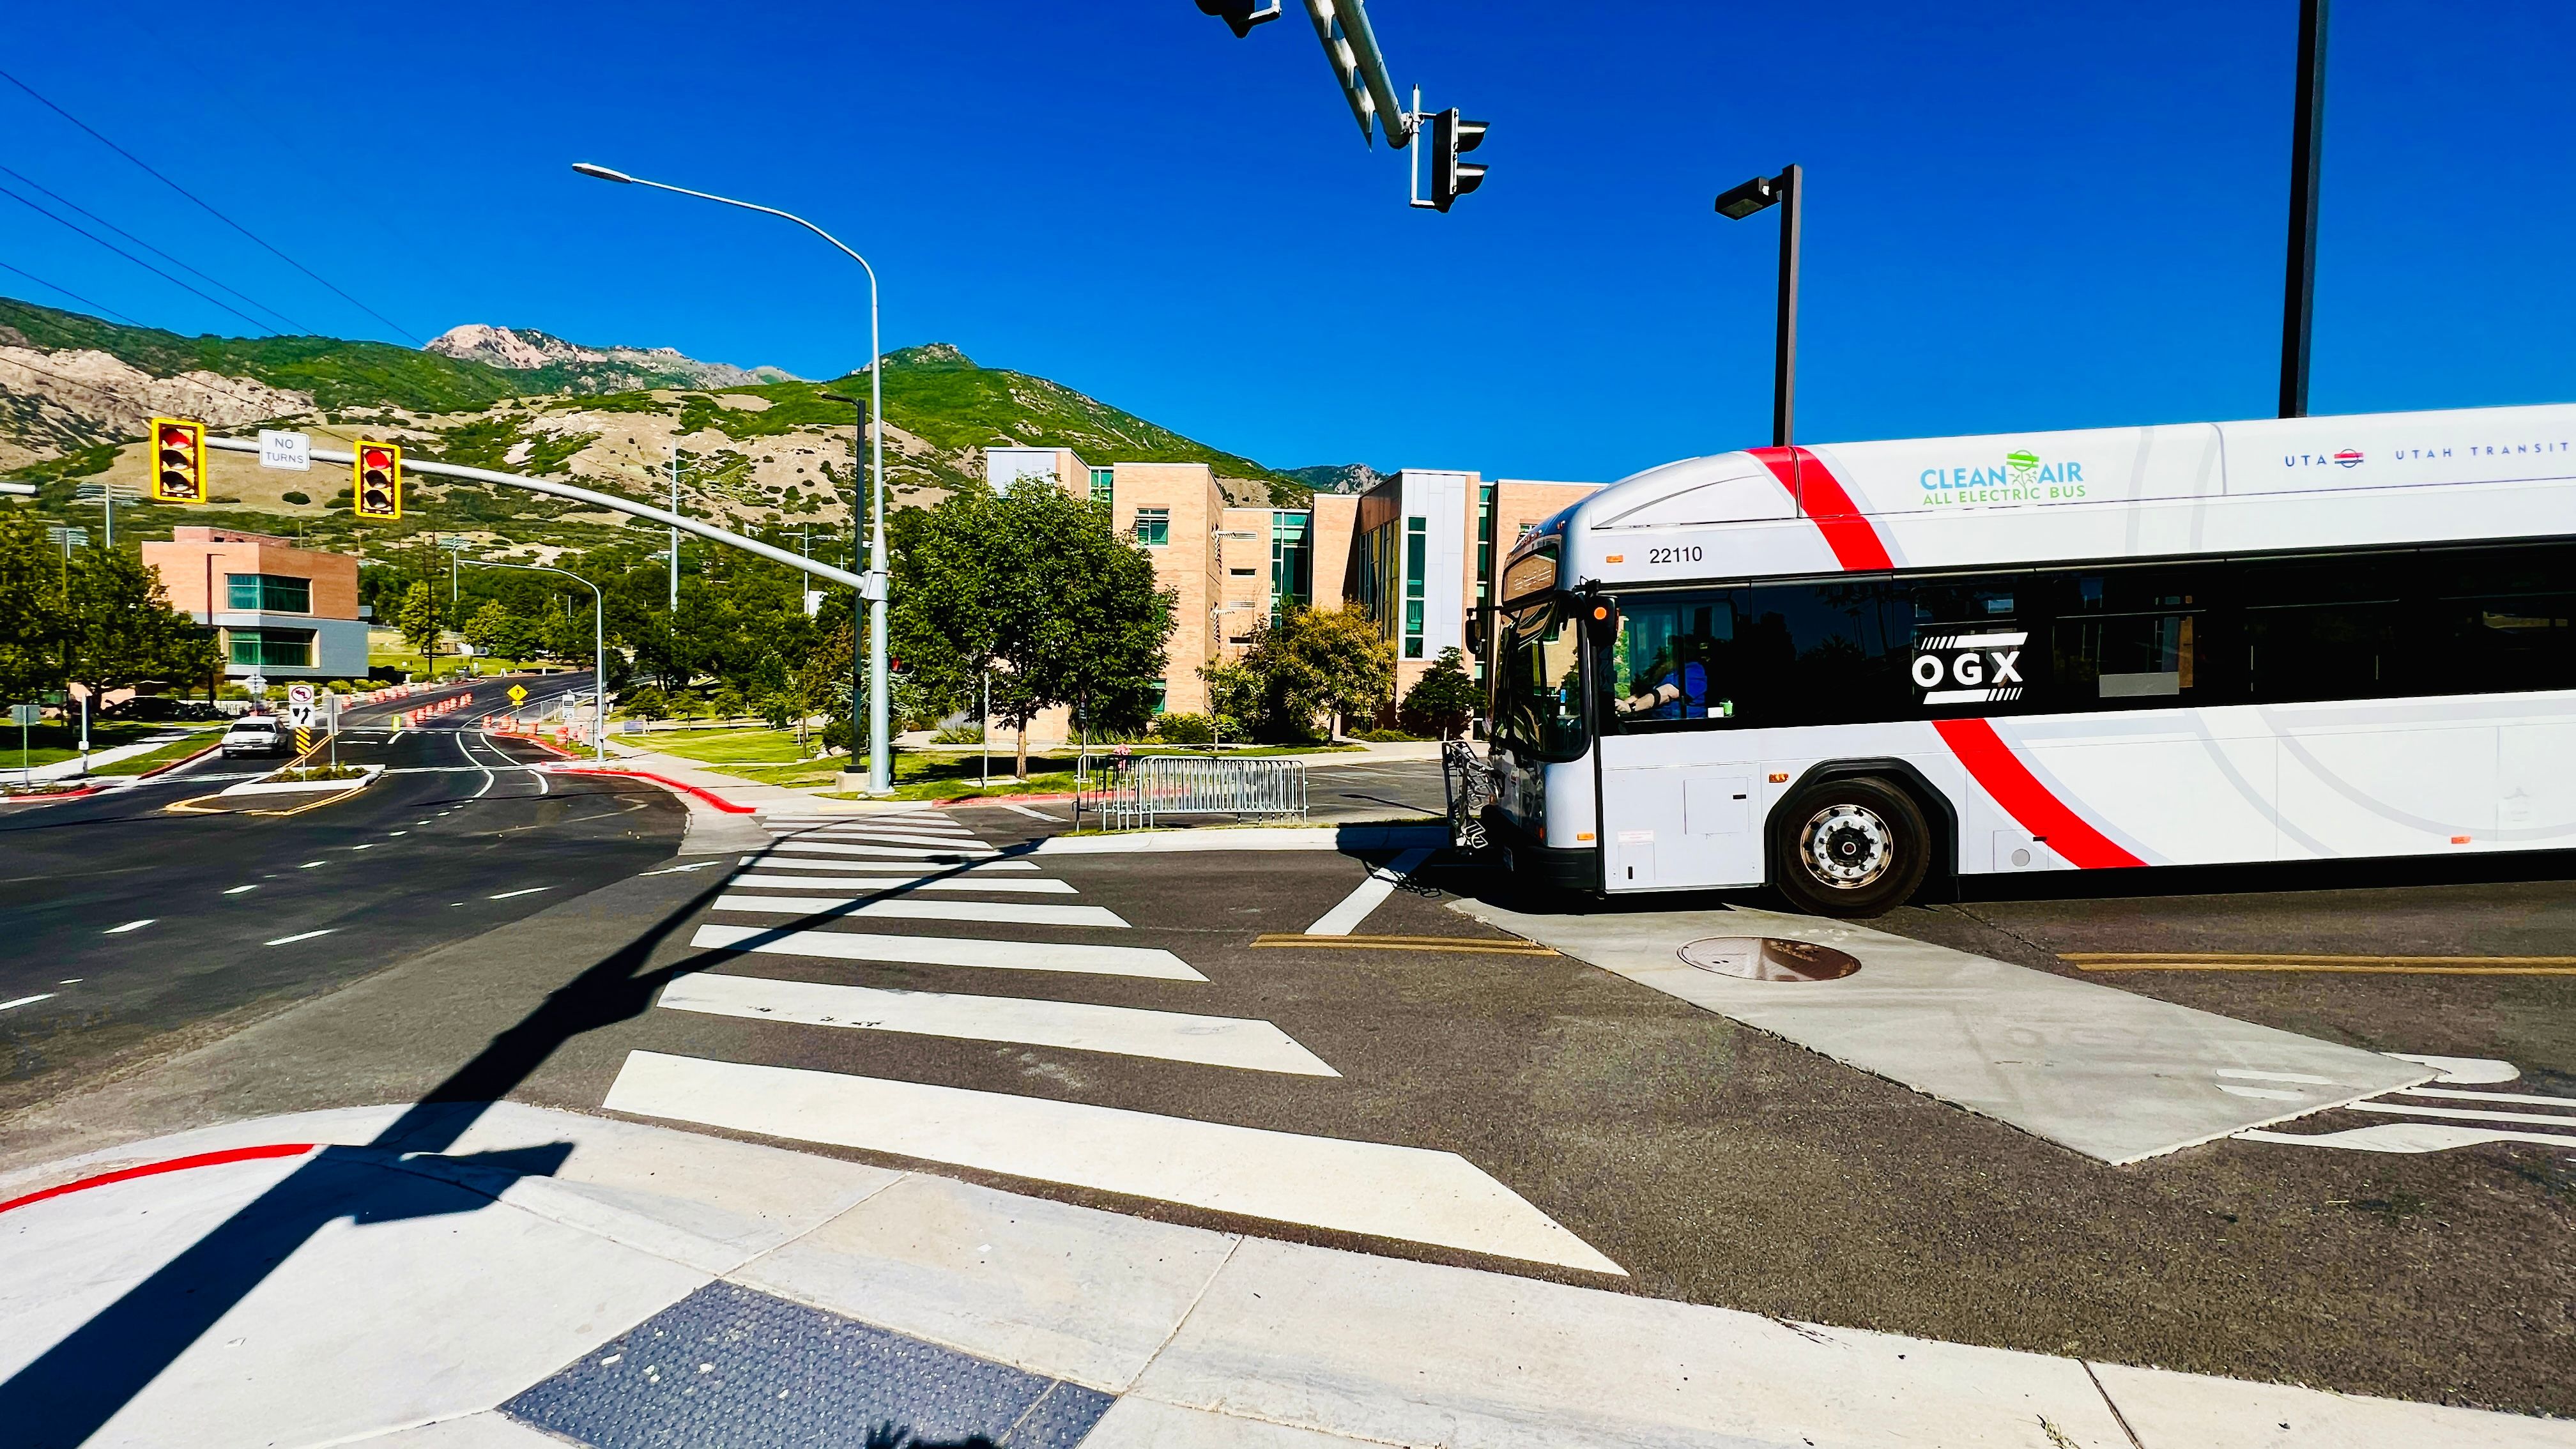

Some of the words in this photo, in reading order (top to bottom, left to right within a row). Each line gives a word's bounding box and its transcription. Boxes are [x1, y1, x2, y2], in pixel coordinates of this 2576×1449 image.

[275, 438, 293, 448] NO
[2396, 448, 2452, 460] UTAH
[2471, 442, 2569, 456] TRANSIT
[266, 452, 303, 463] TURNS
[2285, 454, 2326, 467] UTA
[1920, 466, 2007, 490] CLEAN
[2037, 462, 2083, 484] AIR
[1923, 493, 1952, 505] ALL
[1959, 487, 2040, 503] ELECTRIC
[2050, 485, 2085, 498] BUS
[1649, 546, 1703, 564] 22110
[1912, 651, 2023, 687] OGX
